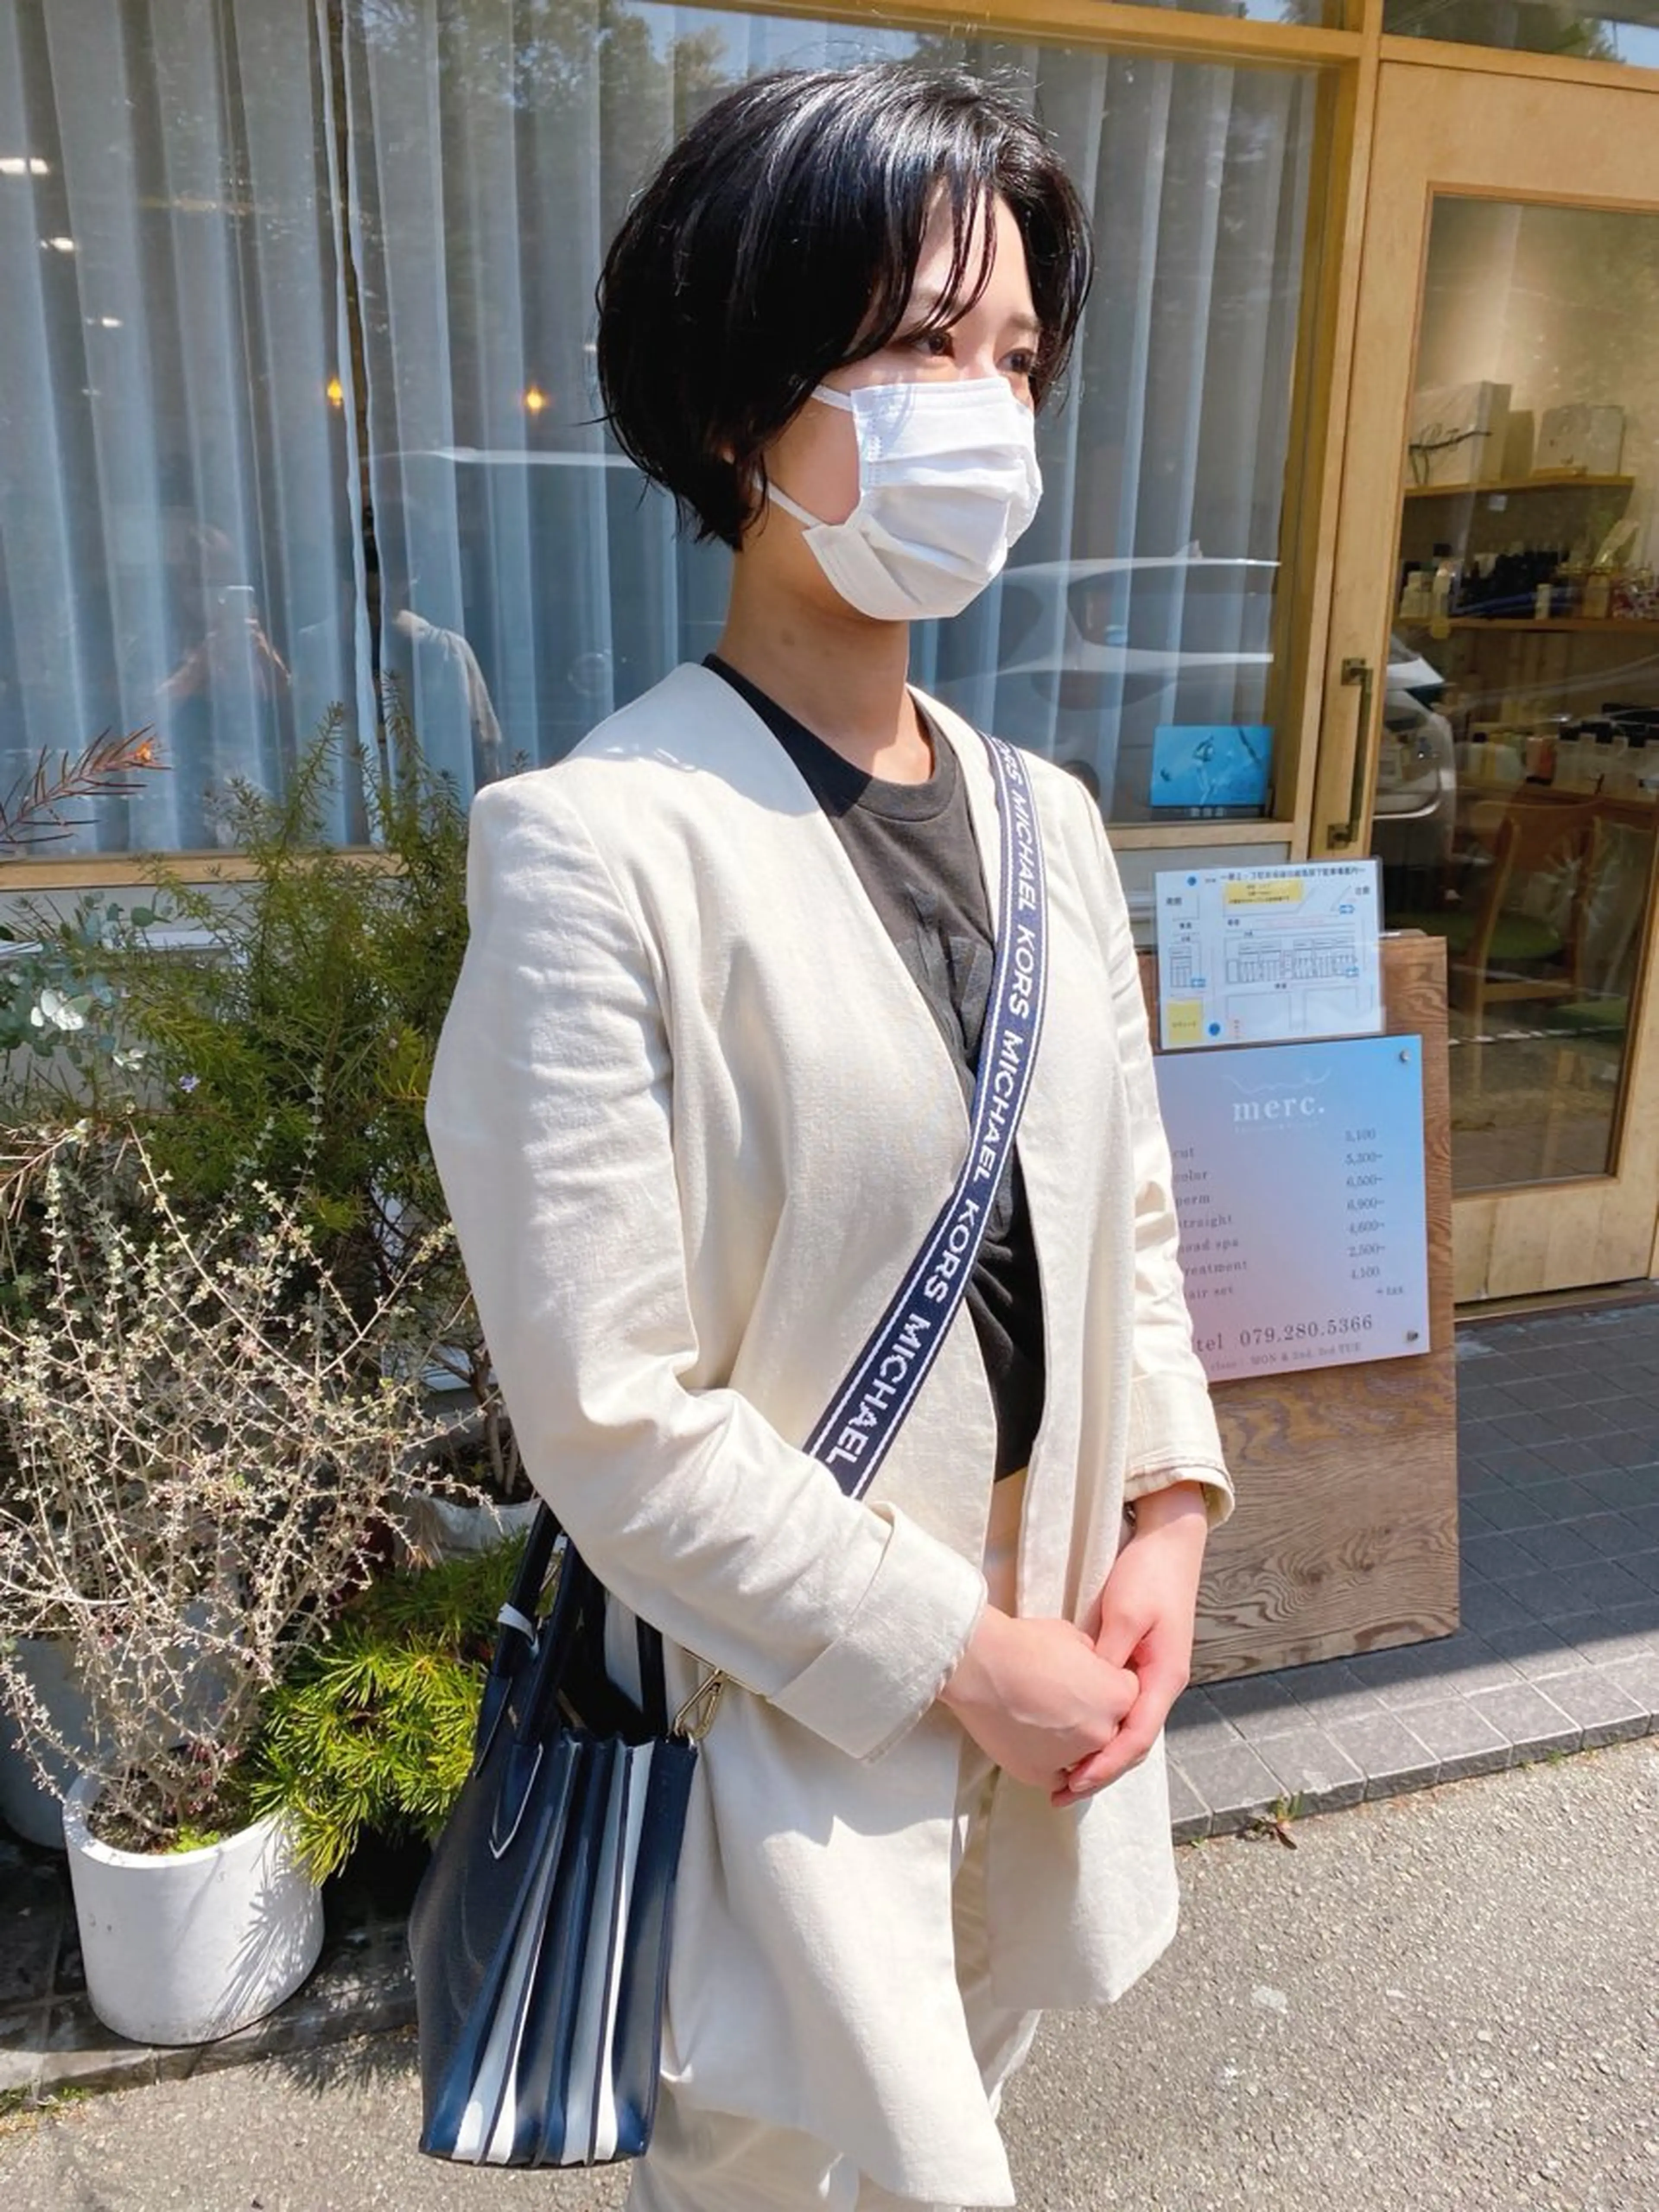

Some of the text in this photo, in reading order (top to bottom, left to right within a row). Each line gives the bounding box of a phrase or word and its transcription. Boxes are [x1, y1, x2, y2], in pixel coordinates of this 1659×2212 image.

[825, 736, 1036, 1464] ORS MICHAEL KORS MICHAEL KORS MICHAEL
[1232, 1096, 1325, 1122] merc.
[1184, 1261, 1247, 1277] reatment
[1196, 1314, 1373, 1353] tel 079.280.5366
